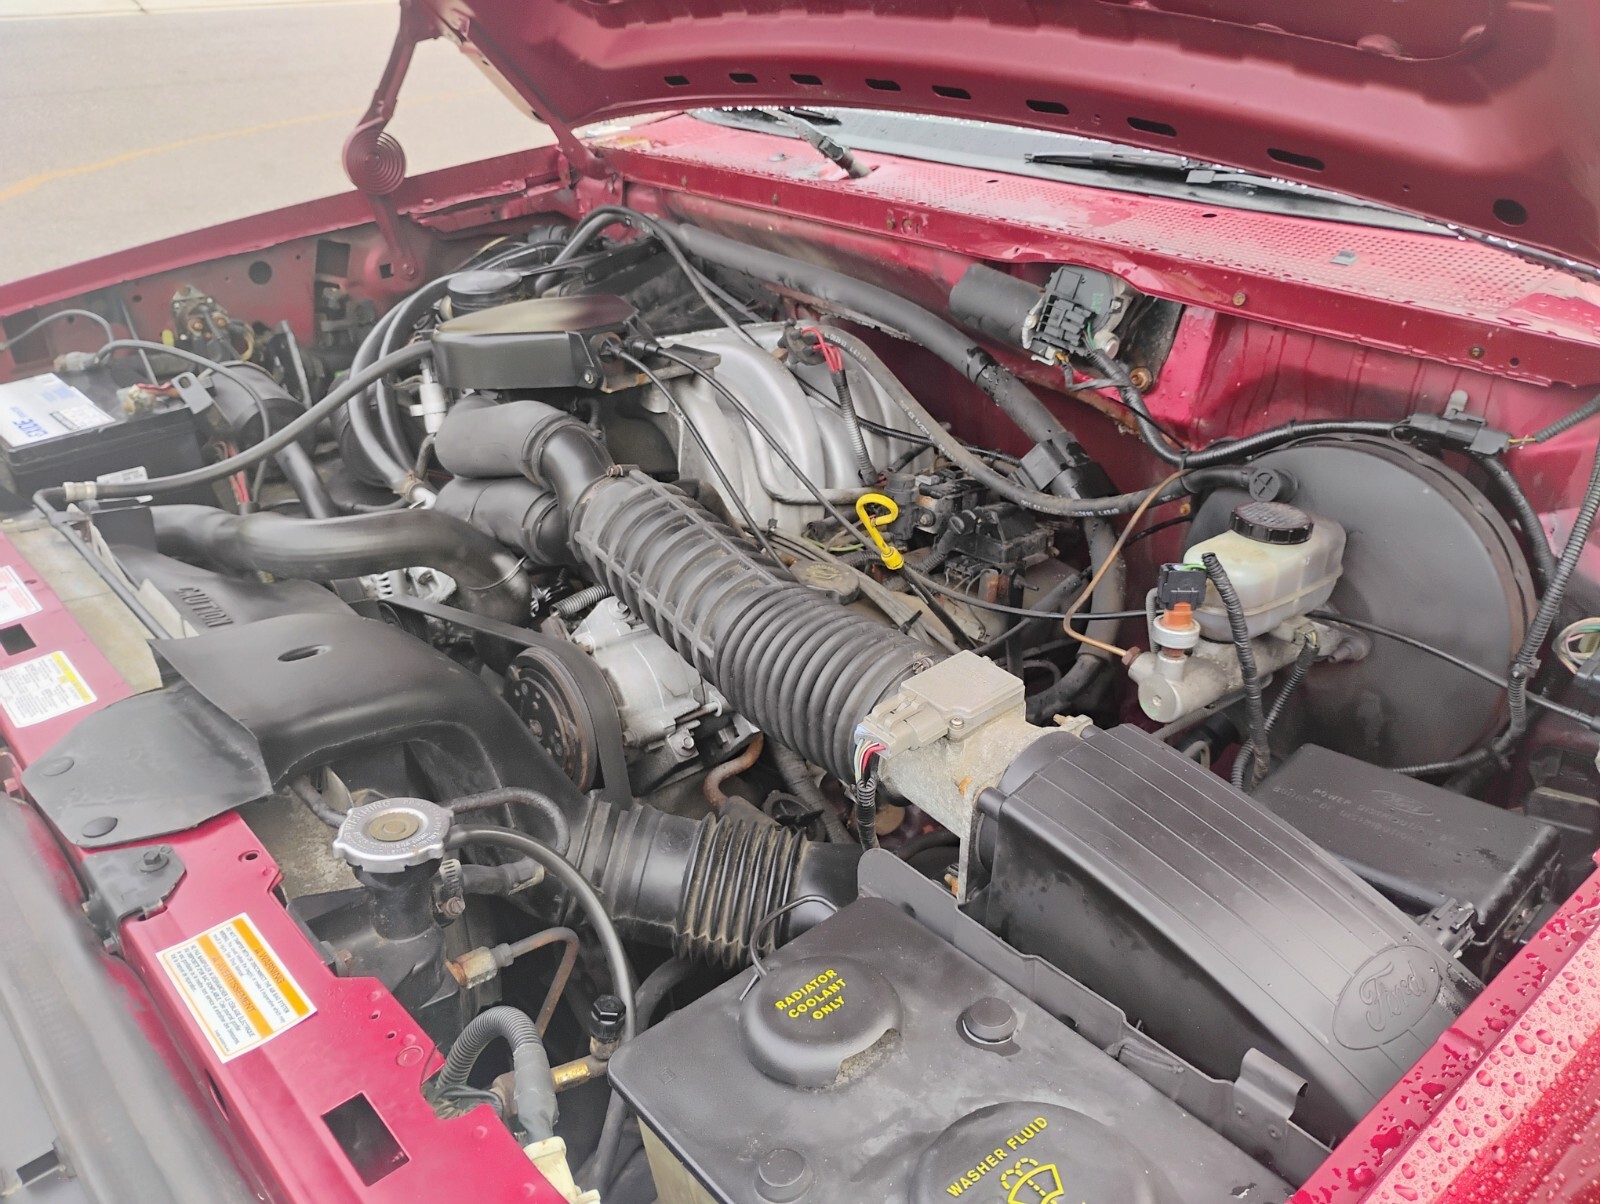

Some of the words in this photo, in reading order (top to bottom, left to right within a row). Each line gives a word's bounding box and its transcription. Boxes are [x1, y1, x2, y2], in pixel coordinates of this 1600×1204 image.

[215, 962, 255, 1013] AVERTISSEMENT
[258, 952, 285, 984] WARNING
[775, 969, 837, 1010] RADIATOR
[788, 978, 846, 1018] COOLANT
[812, 995, 844, 1020] ONLY
[1359, 960, 1427, 1032] Ford
[946, 1148, 1008, 1197] WASHER
[1006, 1117, 1048, 1151] FLUID
